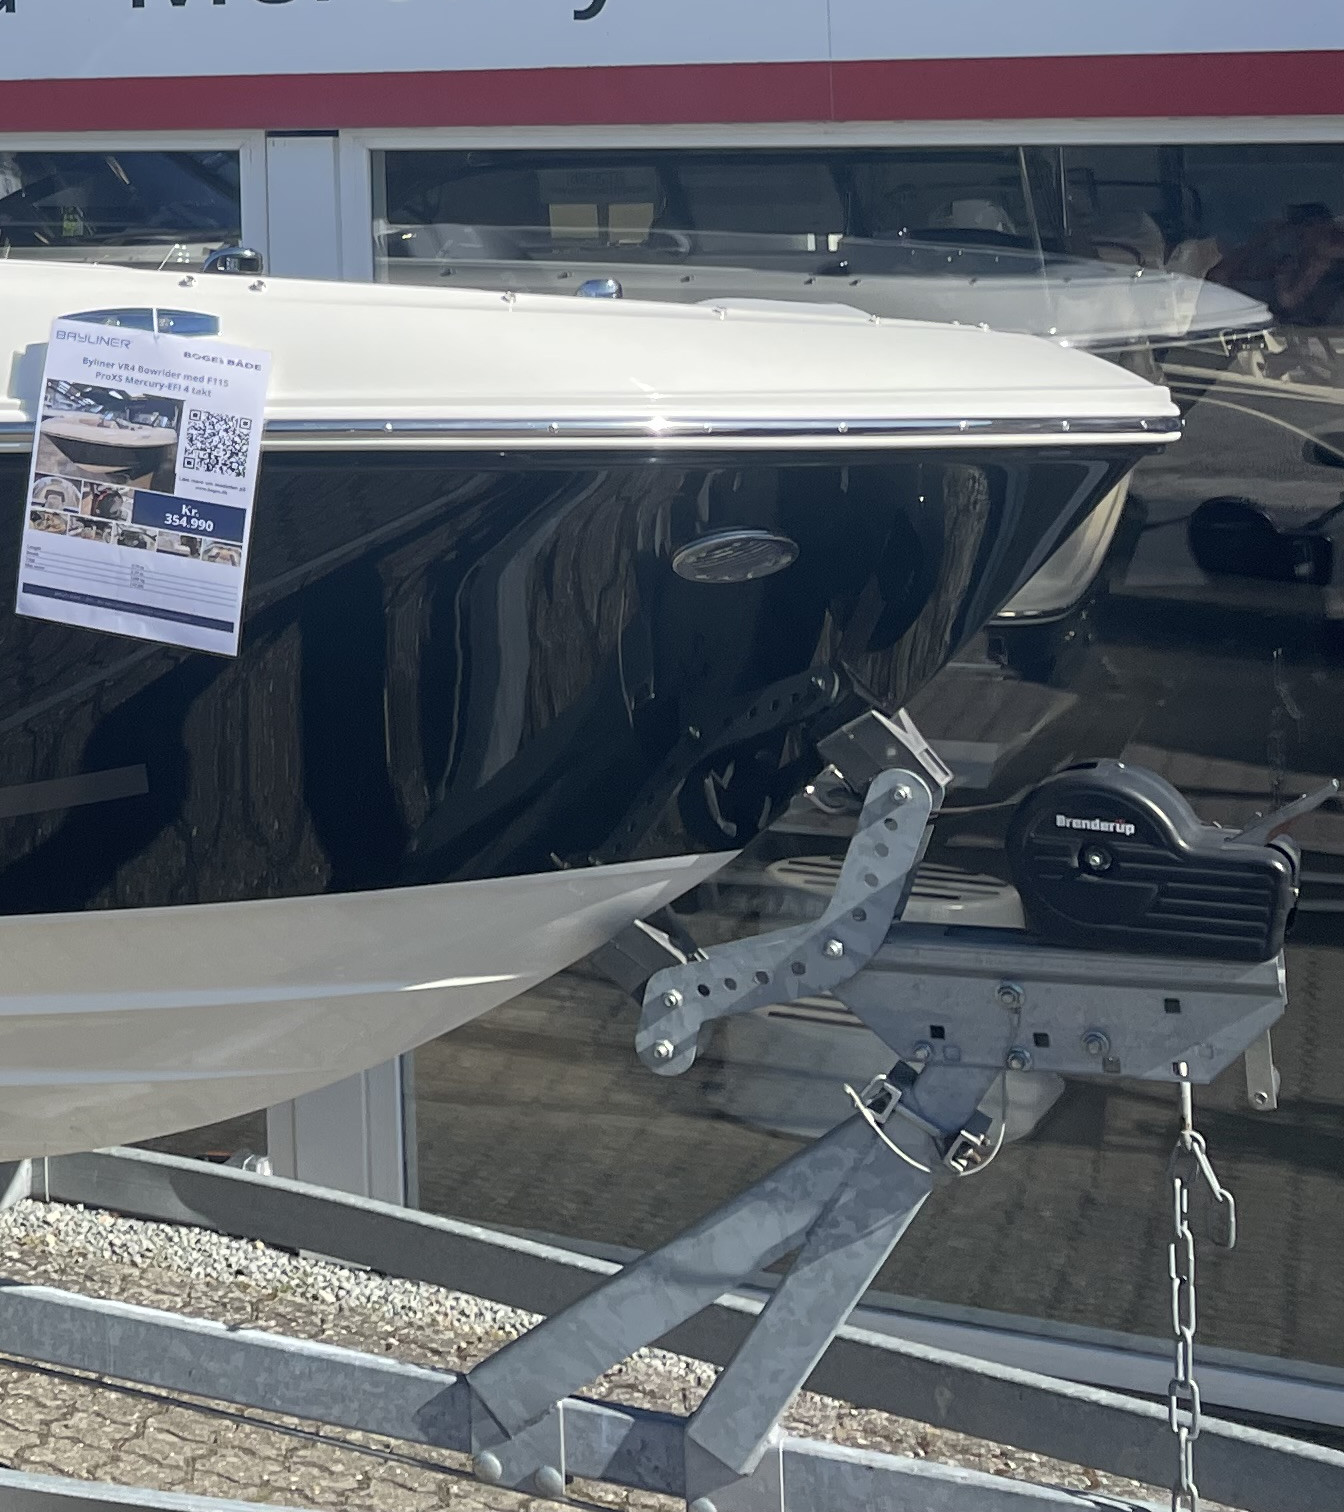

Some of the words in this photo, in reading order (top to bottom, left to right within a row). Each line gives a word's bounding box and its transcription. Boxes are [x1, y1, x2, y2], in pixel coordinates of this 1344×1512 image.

[55, 329, 132, 350] BAYLINER
[95, 371, 123, 384] ProXS
[183, 384, 190, 393] 4
[137, 365, 181, 381] Bowrider
[182, 373, 205, 384] med
[206, 376, 230, 388] F115
[181, 504, 200, 518] Kr.
[163, 512, 214, 532] 354.990
[1055, 813, 1136, 836] Brenderup
